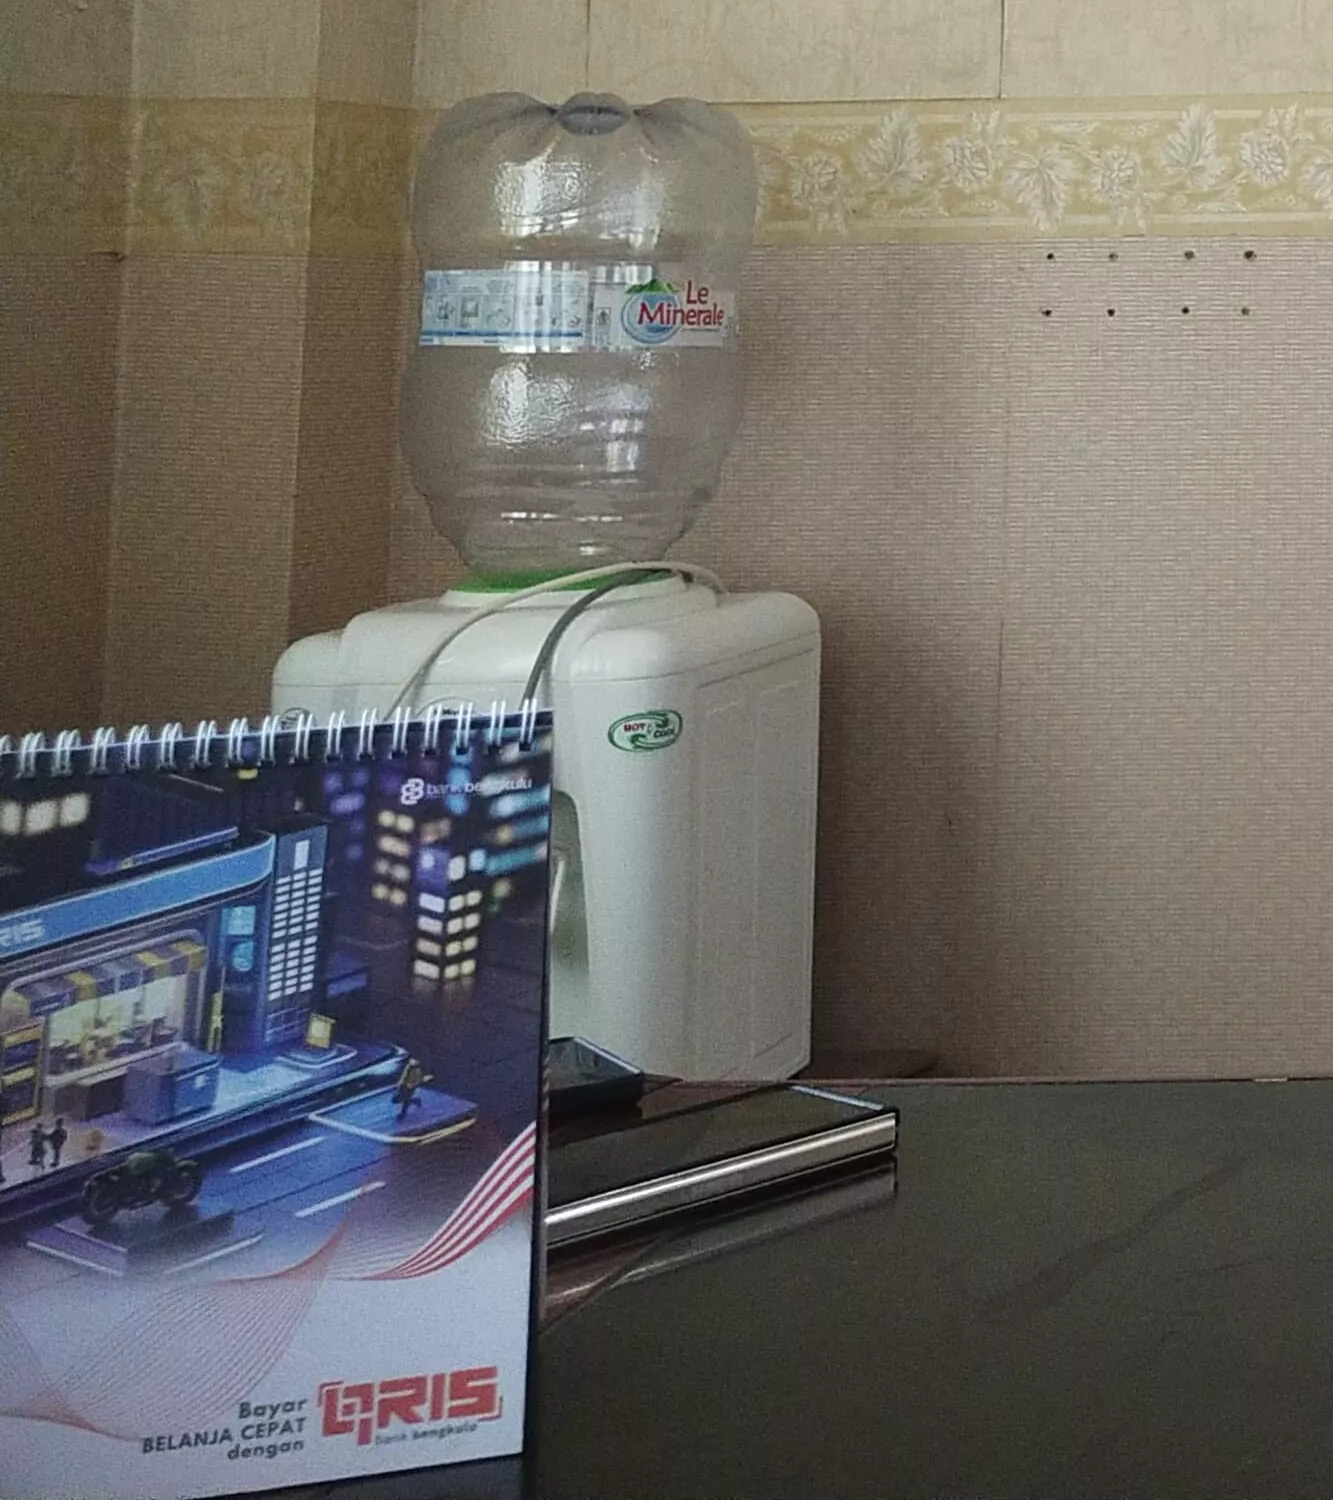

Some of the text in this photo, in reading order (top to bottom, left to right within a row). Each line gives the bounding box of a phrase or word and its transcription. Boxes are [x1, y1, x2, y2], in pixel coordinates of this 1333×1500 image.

[686, 280, 710, 305] Le
[637, 300, 725, 327] Minerale
[238, 1398, 309, 1420] Bayar
[318, 1365, 503, 1446] QRIS
[141, 1417, 307, 1455] BELANJA CEPAT
[227, 1438, 304, 1462] dengan
